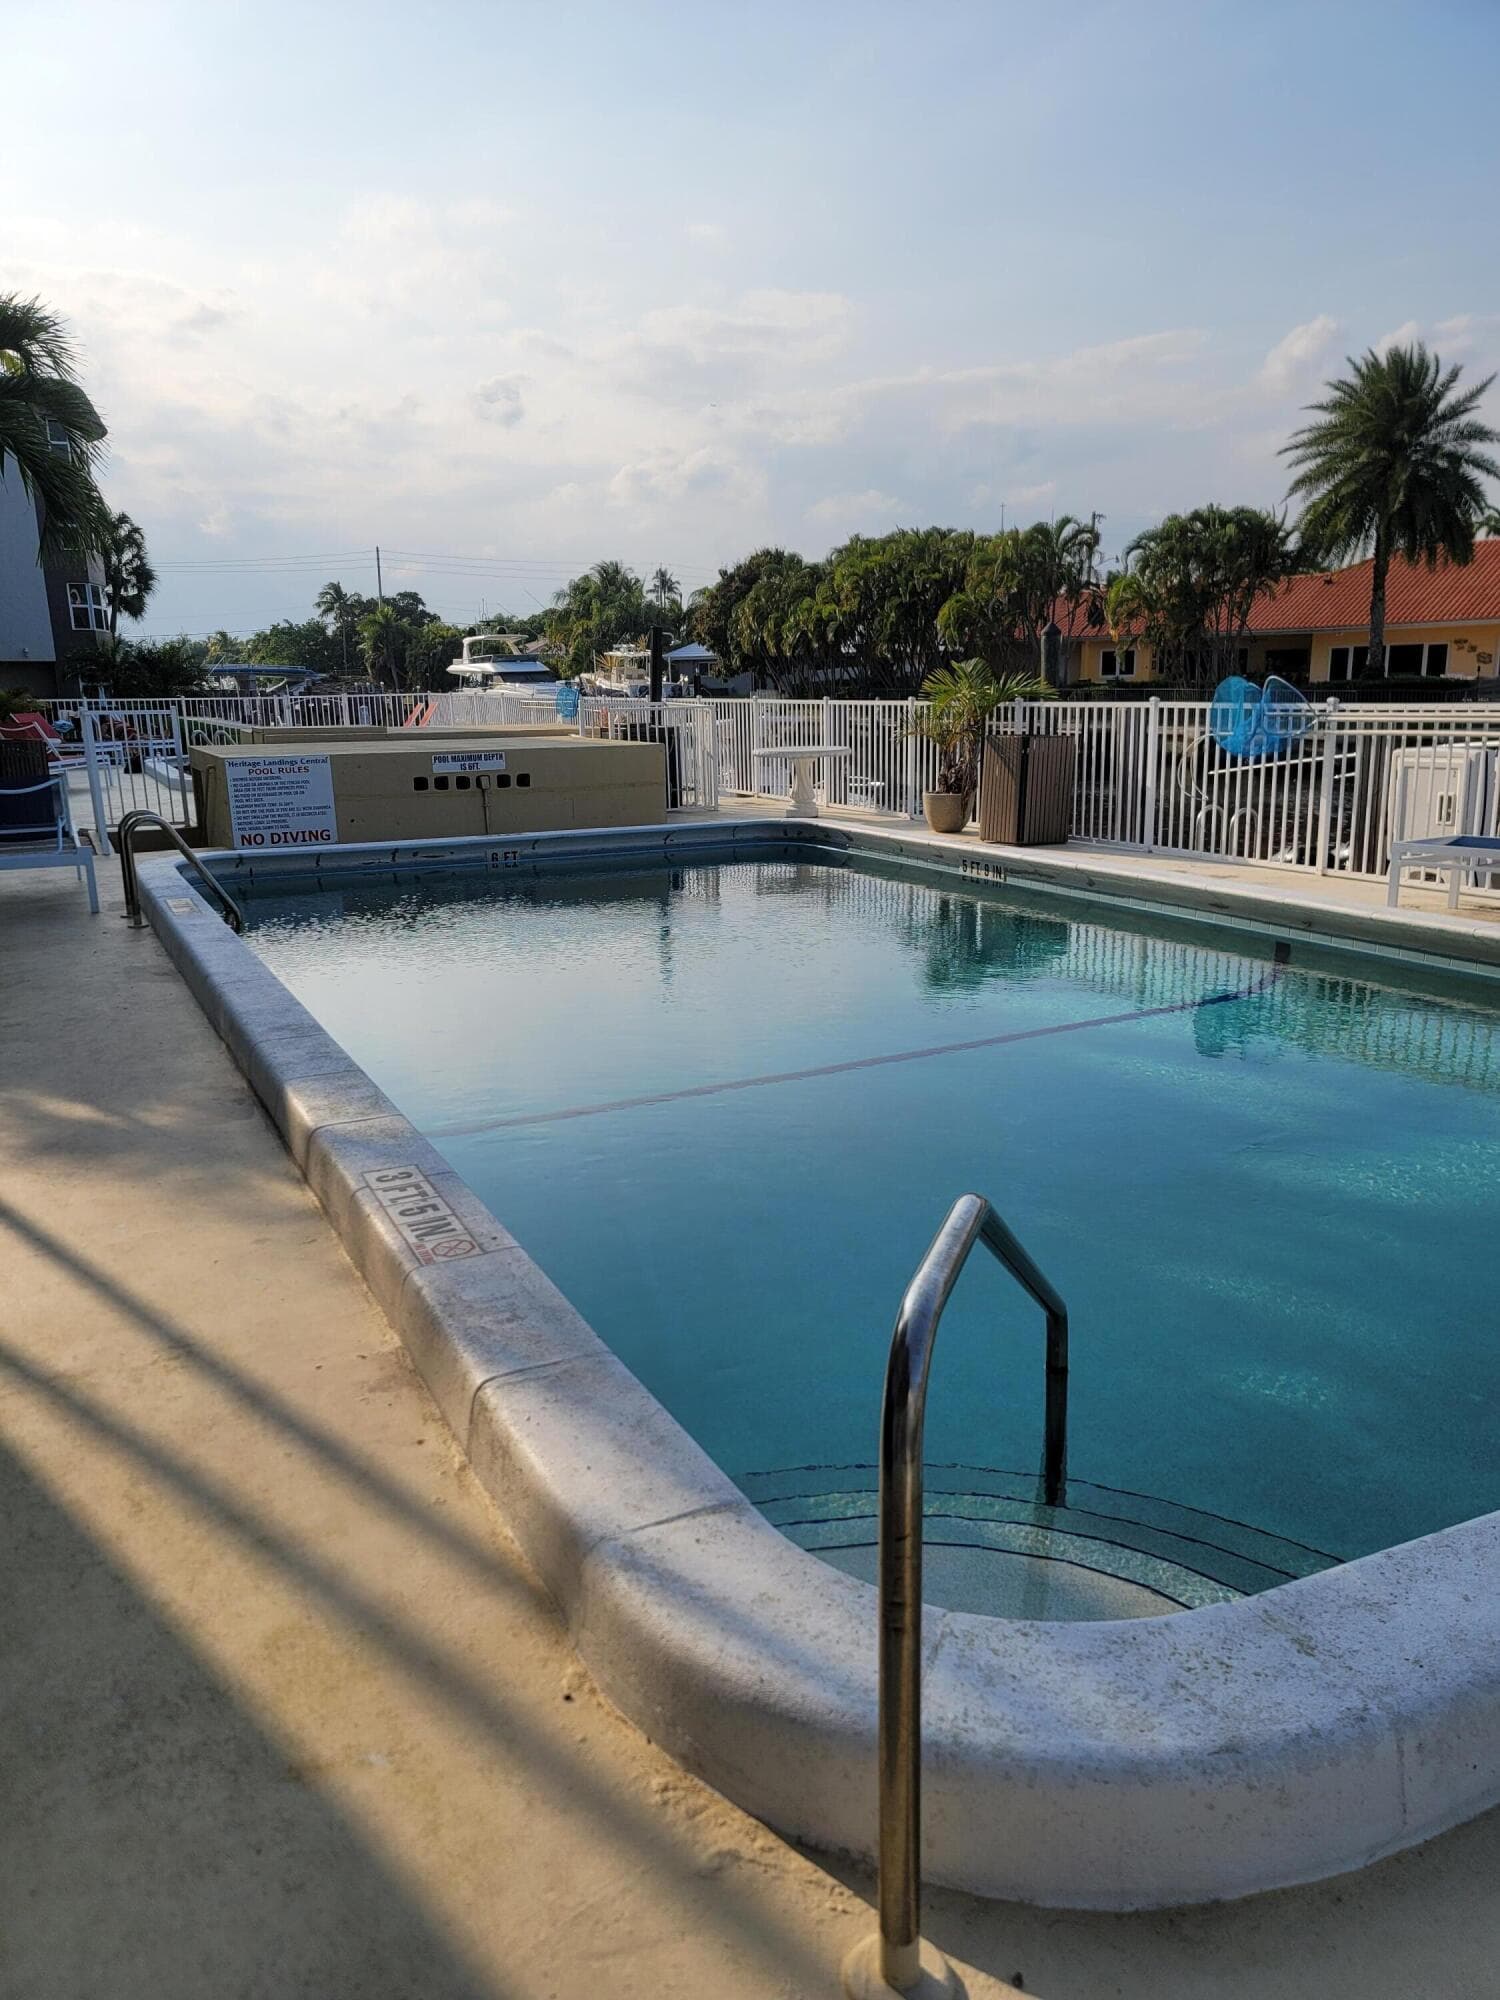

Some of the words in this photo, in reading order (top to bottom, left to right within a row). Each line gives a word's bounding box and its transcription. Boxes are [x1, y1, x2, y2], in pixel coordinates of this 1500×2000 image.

[227, 760, 261, 769] Heritage
[263, 758, 298, 767] Landings
[300, 756, 328, 765] Central
[433, 755, 450, 764] POOL
[451, 753, 483, 763] MAXIMUM
[484, 752, 504, 761] DEPTH
[248, 767, 276, 776] POOL
[278, 765, 310, 774] RULES
[460, 763, 467, 771] IS
[240, 833, 265, 846] NO
[270, 829, 331, 845] DIVING
[503, 850, 518, 861] FT
[962, 859, 968, 873] 5
[970, 860, 981, 876] FT
[992, 864, 1002, 880] IN
[375, 1171, 414, 1183] 3
[397, 1203, 441, 1217] 5
